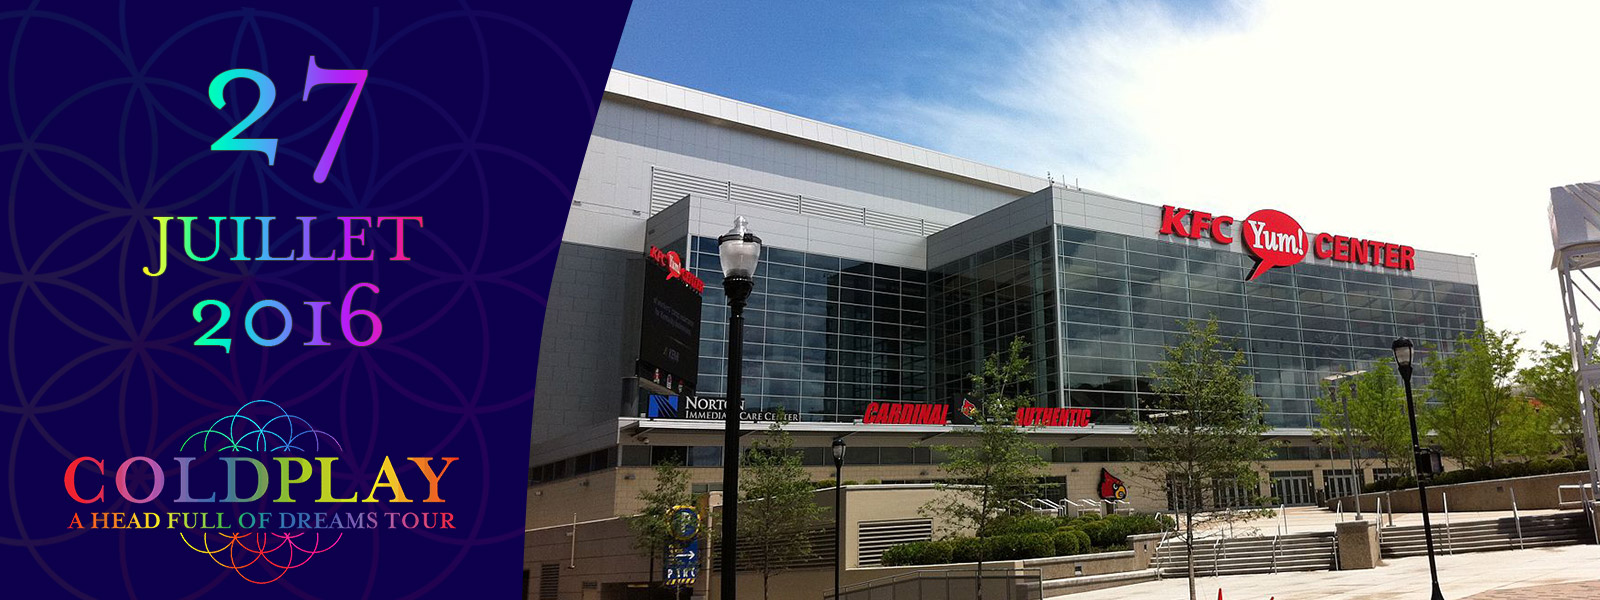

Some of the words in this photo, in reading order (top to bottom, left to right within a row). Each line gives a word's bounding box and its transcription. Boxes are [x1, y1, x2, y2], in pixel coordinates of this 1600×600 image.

[1159, 205, 1234, 244] KFC
[1248, 219, 1304, 256] Yum!
[1313, 232, 1415, 271] CENTER
[650, 245, 667, 267] KFC
[685, 396, 745, 410] NORTN
[685, 410, 727, 420] IMMEDIA
[740, 411, 763, 420] CARE
[764, 412, 799, 421] CETER
[863, 402, 949, 425] CARDINAL
[1014, 408, 1092, 427] AUTHENTIC
